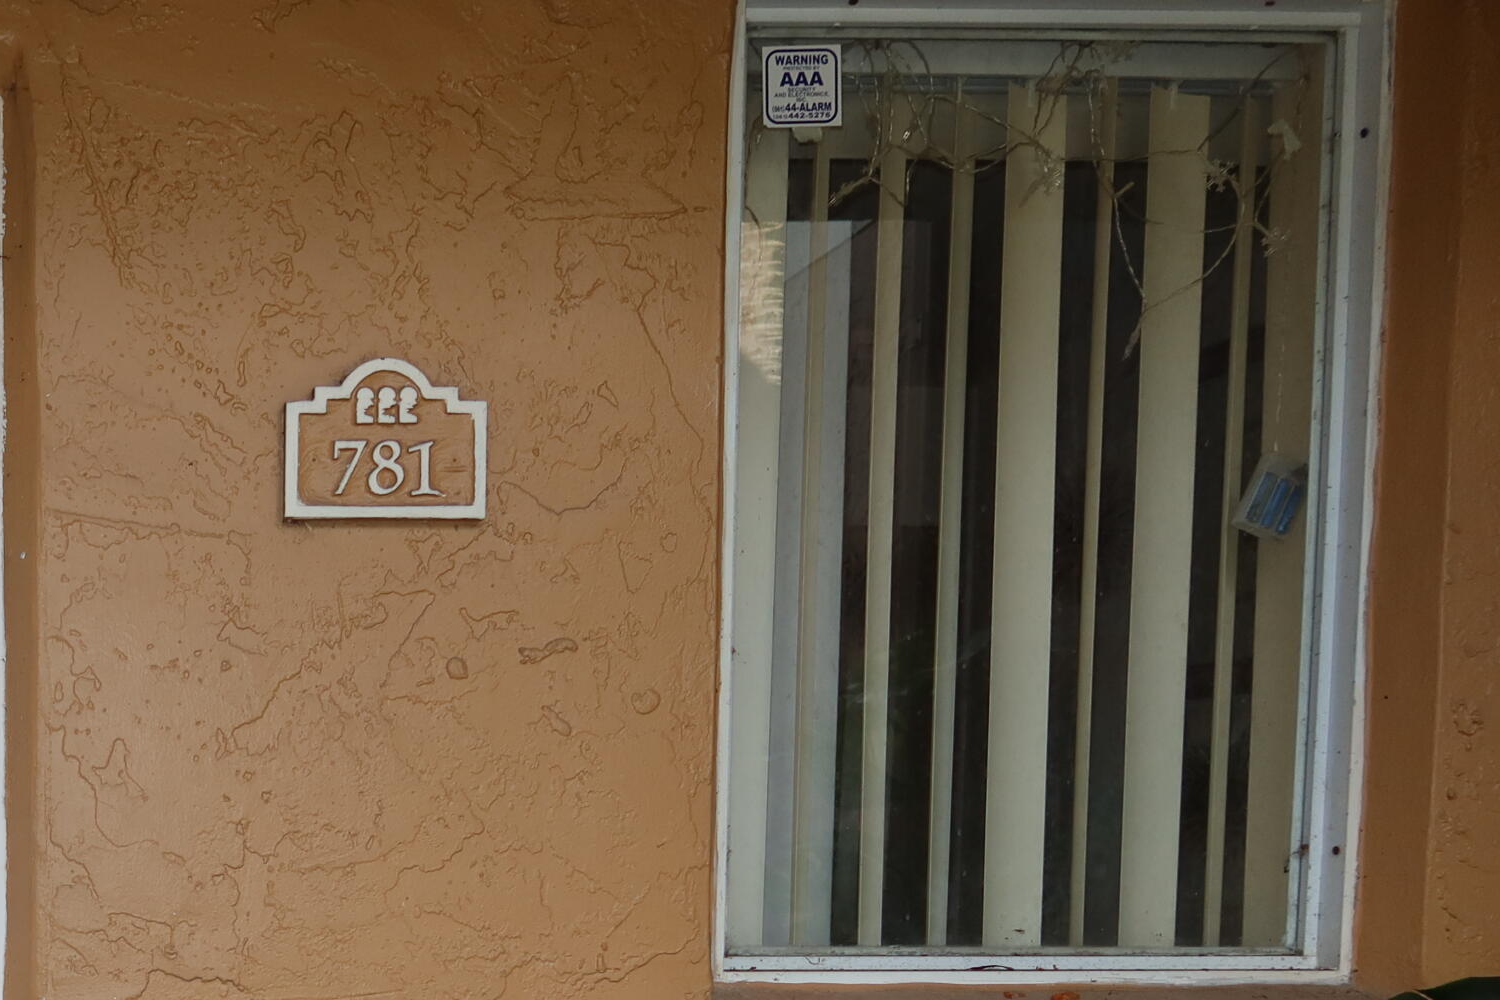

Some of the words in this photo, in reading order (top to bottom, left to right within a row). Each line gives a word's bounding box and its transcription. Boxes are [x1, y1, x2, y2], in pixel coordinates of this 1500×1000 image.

[775, 54, 829, 66] WARNING
[780, 71, 824, 88] AAA
[333, 440, 447, 498] 781
